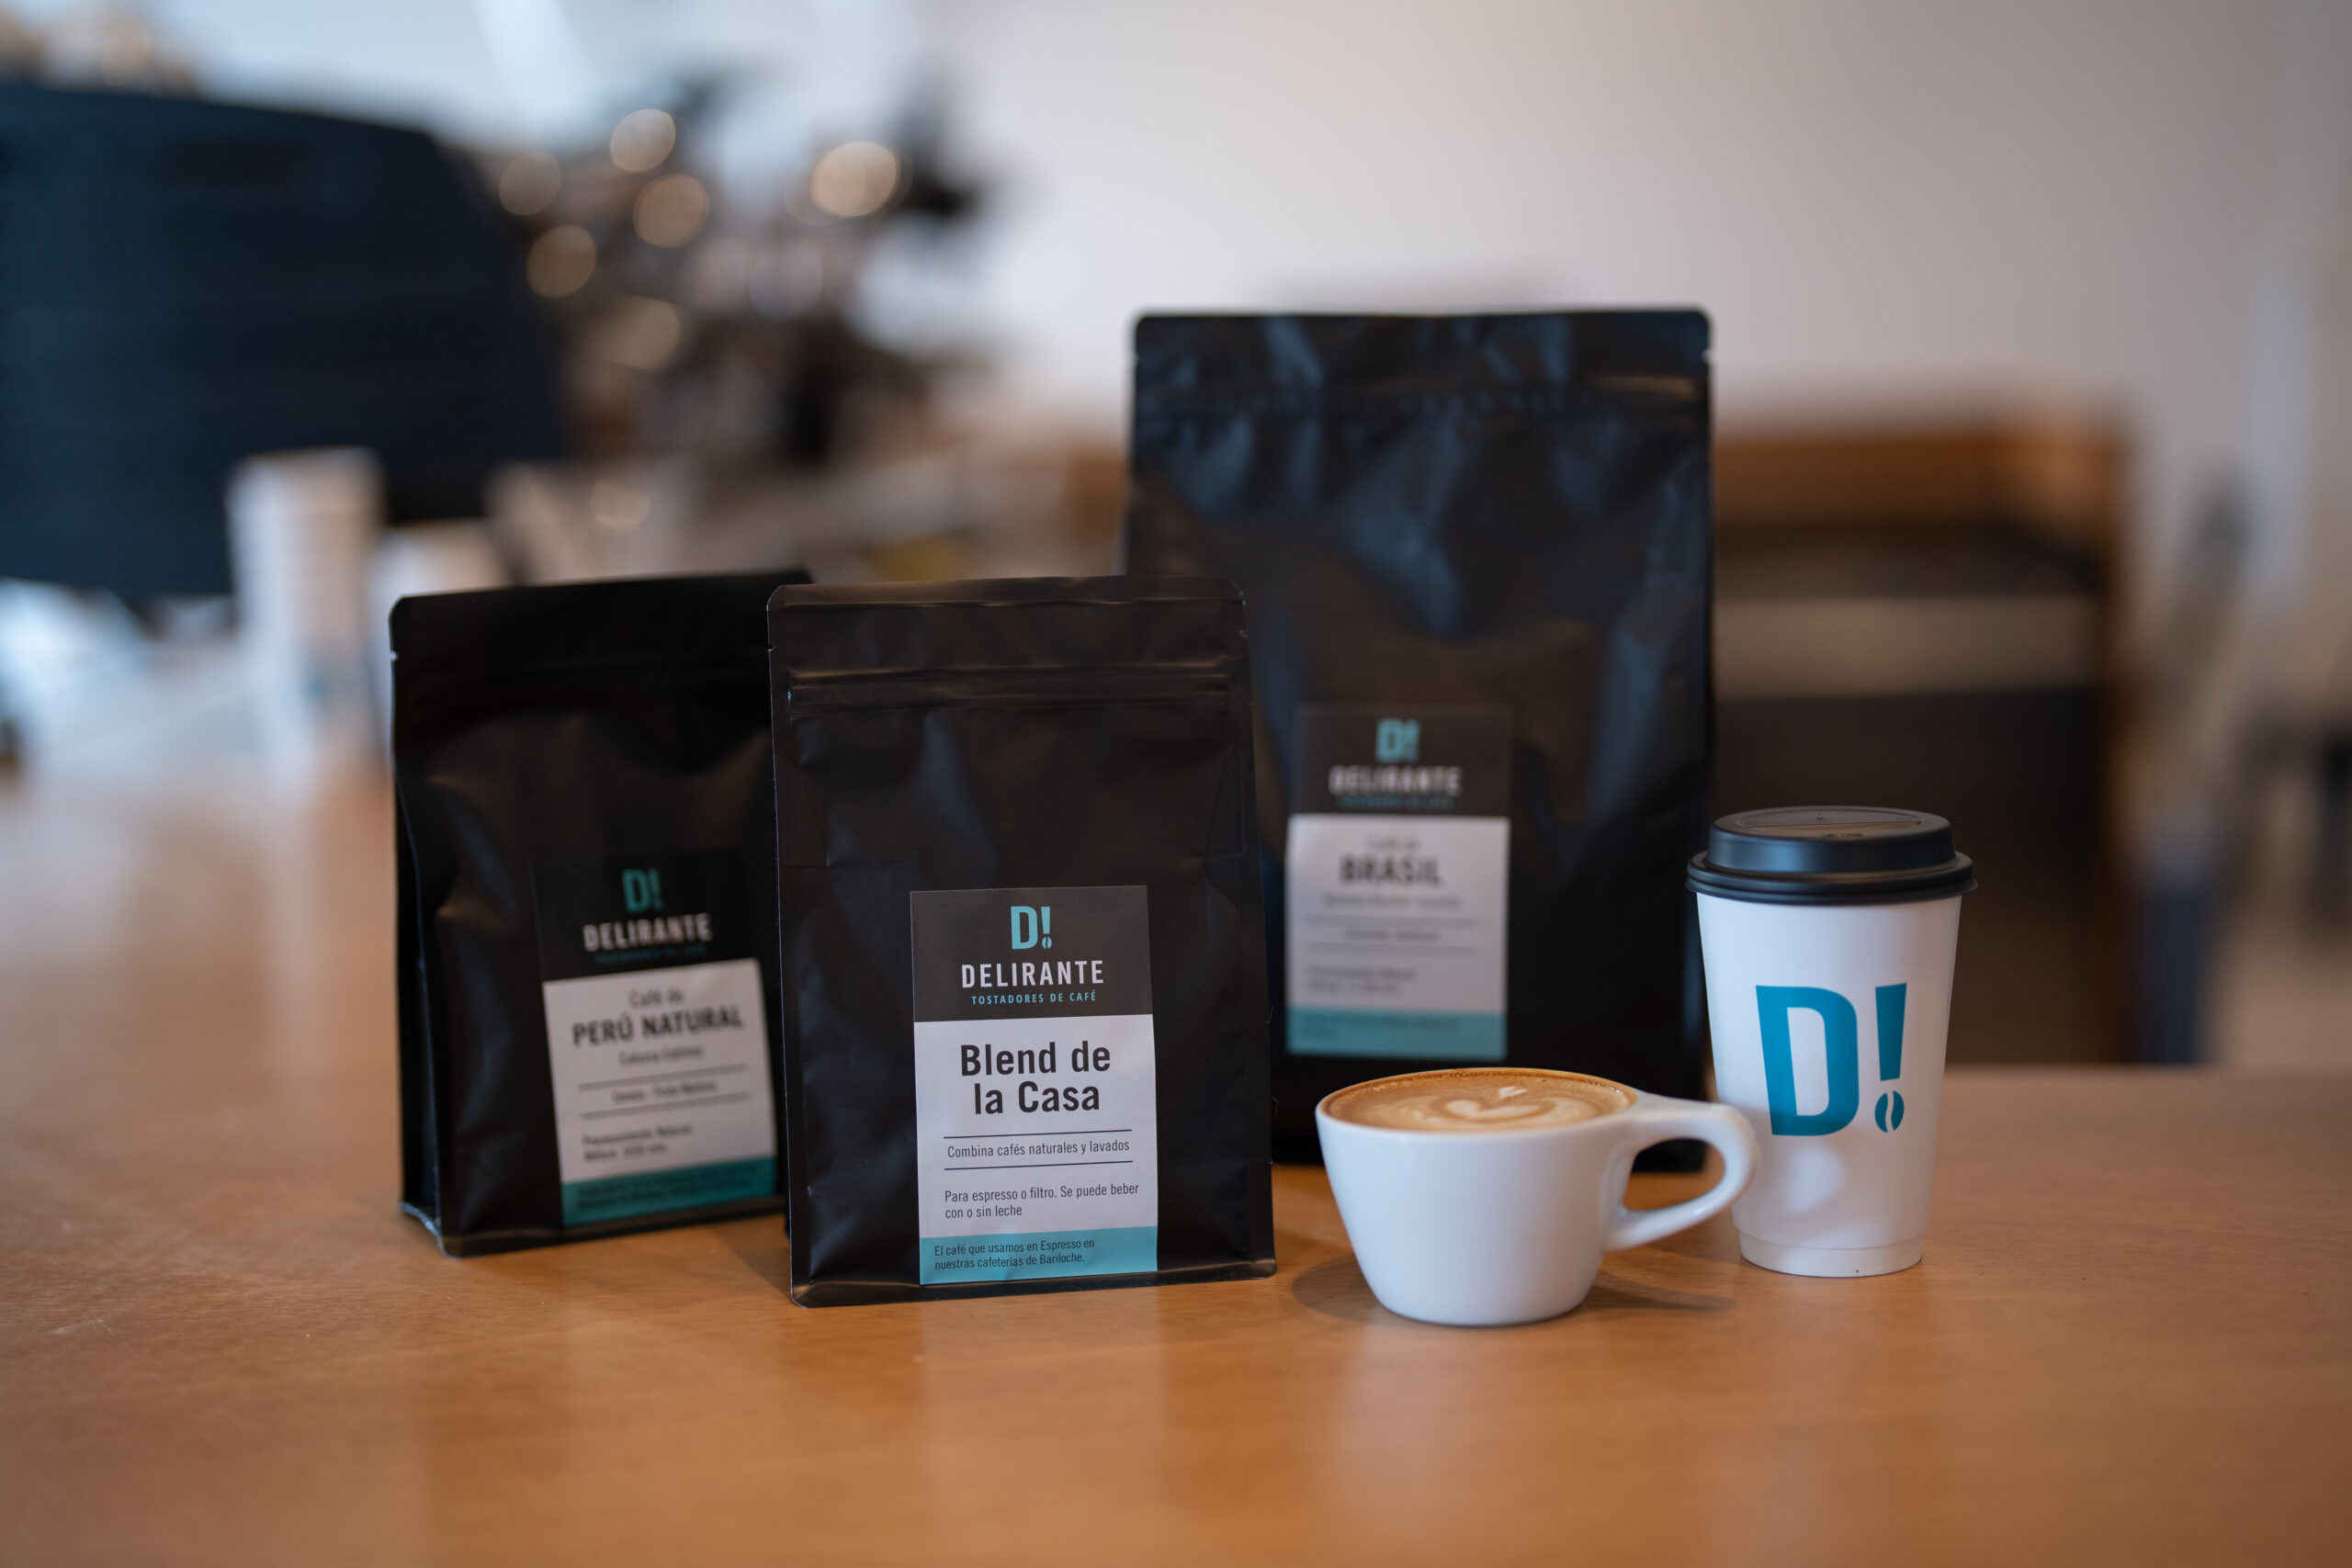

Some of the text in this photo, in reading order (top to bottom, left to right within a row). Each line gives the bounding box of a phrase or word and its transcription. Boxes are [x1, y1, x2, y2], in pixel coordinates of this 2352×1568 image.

[622, 867, 663, 913] D!
[582, 913, 713, 952] DELIRANTE
[1011, 906, 1052, 950] D!
[961, 960, 1103, 988] DELIRANTE
[971, 990, 1097, 1006] TOSTADORES DE CAFÉ
[572, 1006, 742, 1045] PERÚ NATURAL
[960, 1040, 1111, 1077] Blend de
[1756, 983, 1907, 1136] D!
[974, 1080, 1100, 1115] la Casa
[947, 1139, 1130, 1158] Combina cafés naturales y lavados
[944, 1183, 1139, 1203] Para espresso o filtro. Se puede beber
[944, 1204, 1023, 1219] con o sin leche
[934, 1239, 1095, 1257] El café que usamos en Espresso en
[934, 1252, 1085, 1270] nuestras cafeterías de Bariloche.
